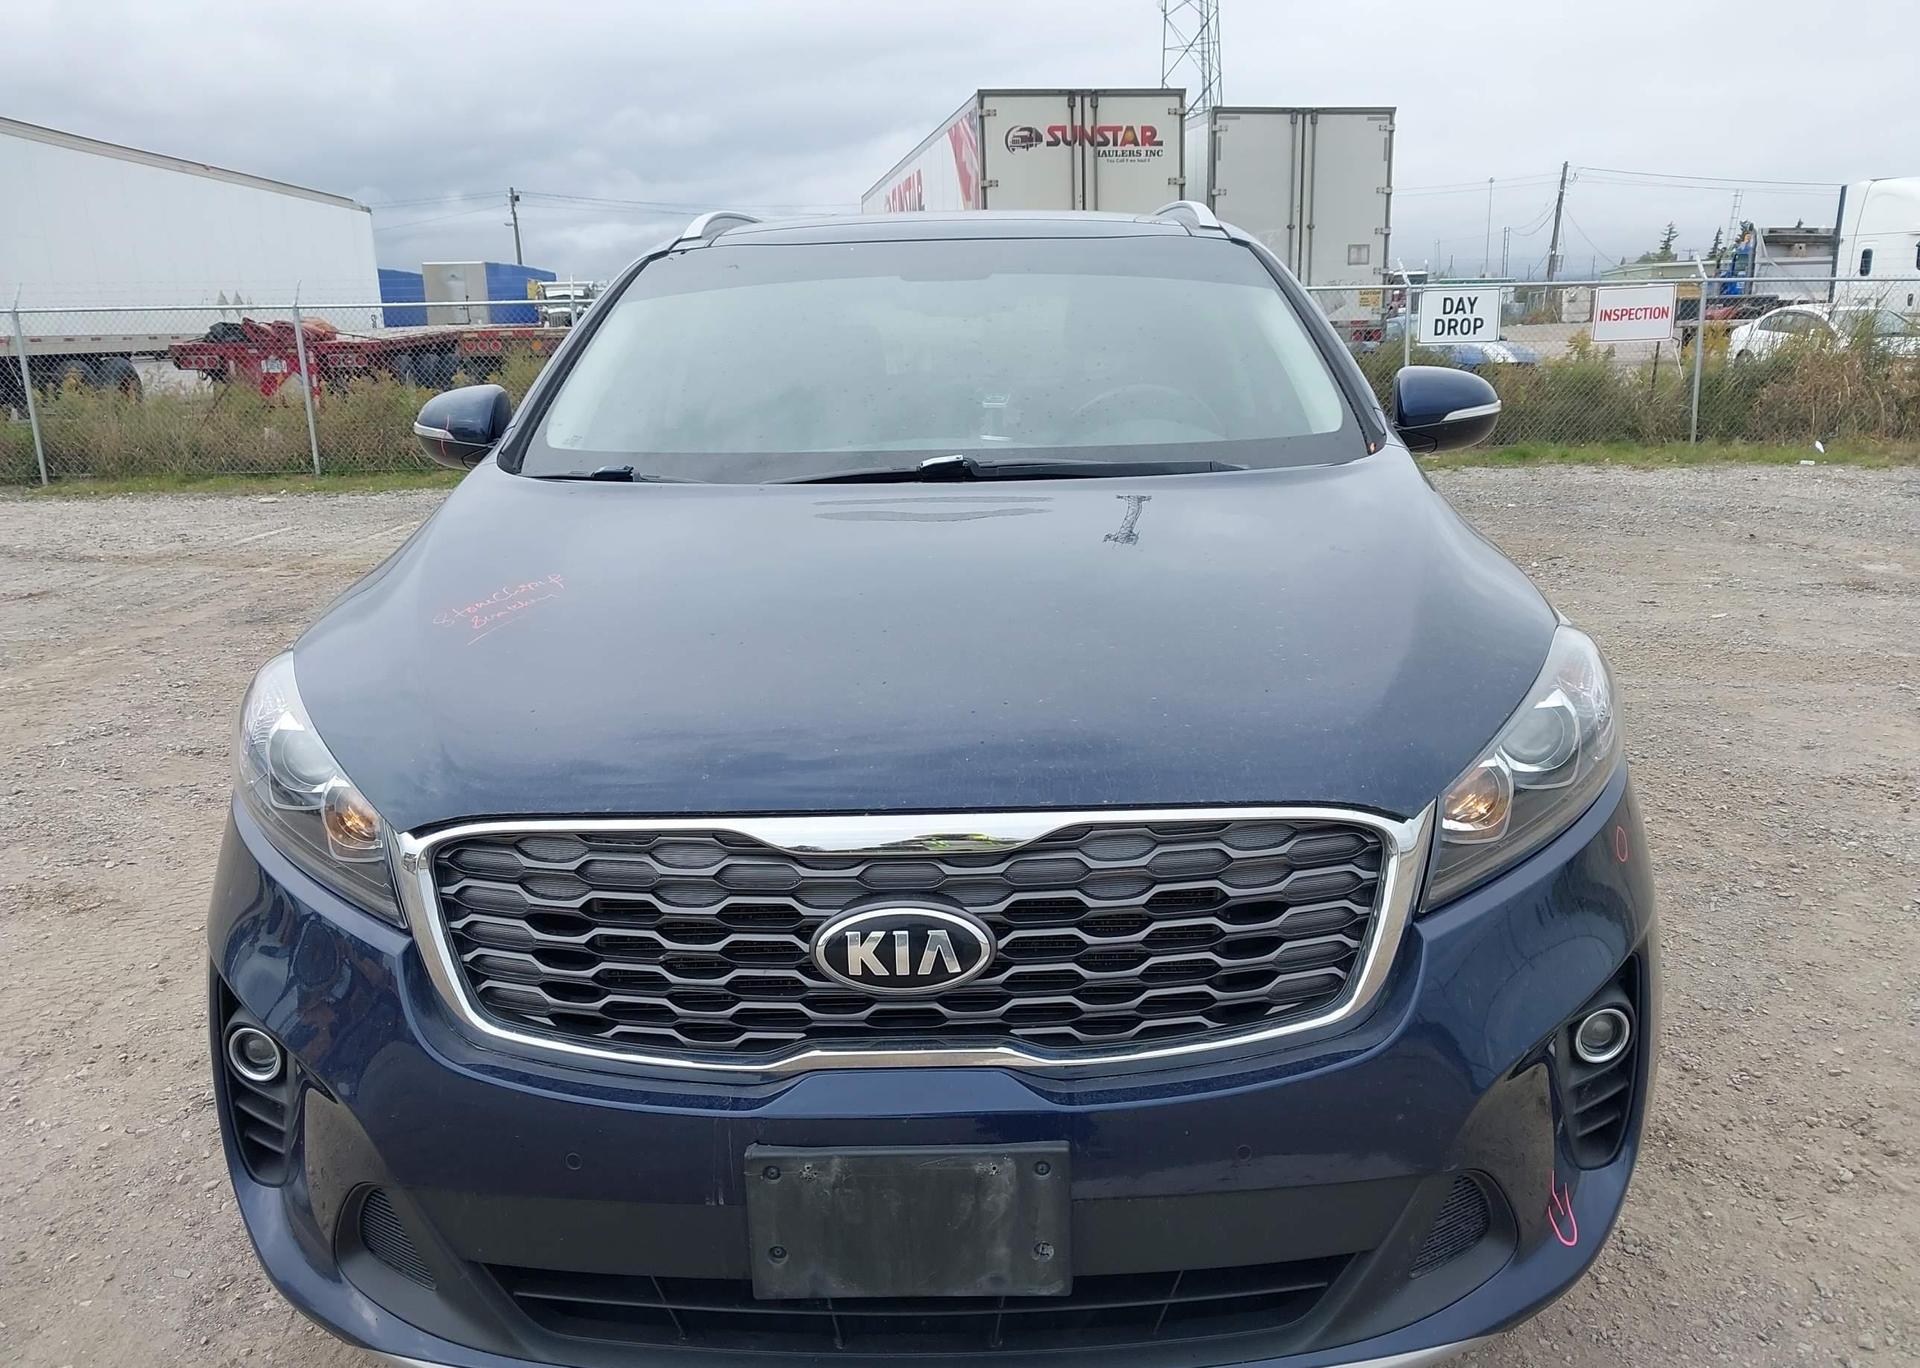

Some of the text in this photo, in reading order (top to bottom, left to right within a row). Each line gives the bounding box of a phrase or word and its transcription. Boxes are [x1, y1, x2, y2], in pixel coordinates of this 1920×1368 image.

[1046, 125, 1163, 147] SUNSTAR
[1145, 149, 1164, 157] INC
[1442, 296, 1479, 315] DAY
[1599, 305, 1670, 322] INSPECTION
[1433, 317, 1485, 336] DROP
[845, 929, 962, 976] KIA
